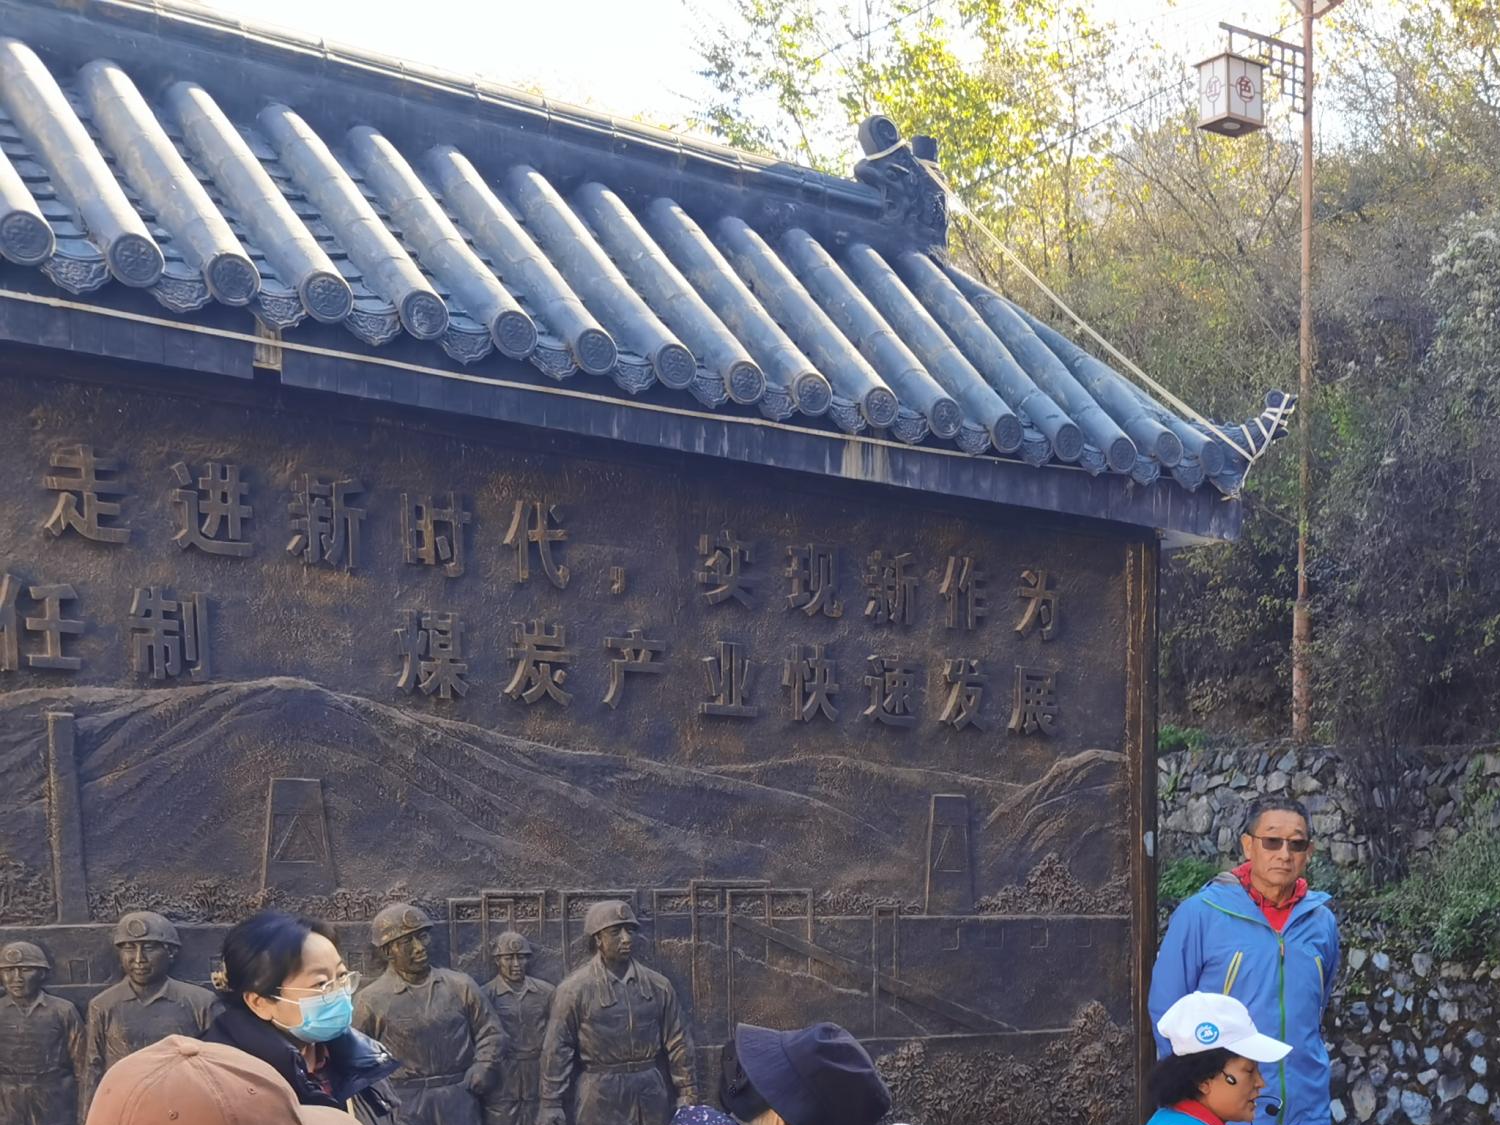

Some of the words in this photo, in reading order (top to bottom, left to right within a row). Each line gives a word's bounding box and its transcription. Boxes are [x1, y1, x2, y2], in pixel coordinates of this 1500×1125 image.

[397, 608, 1061, 736] 煤炭产业快速发展
